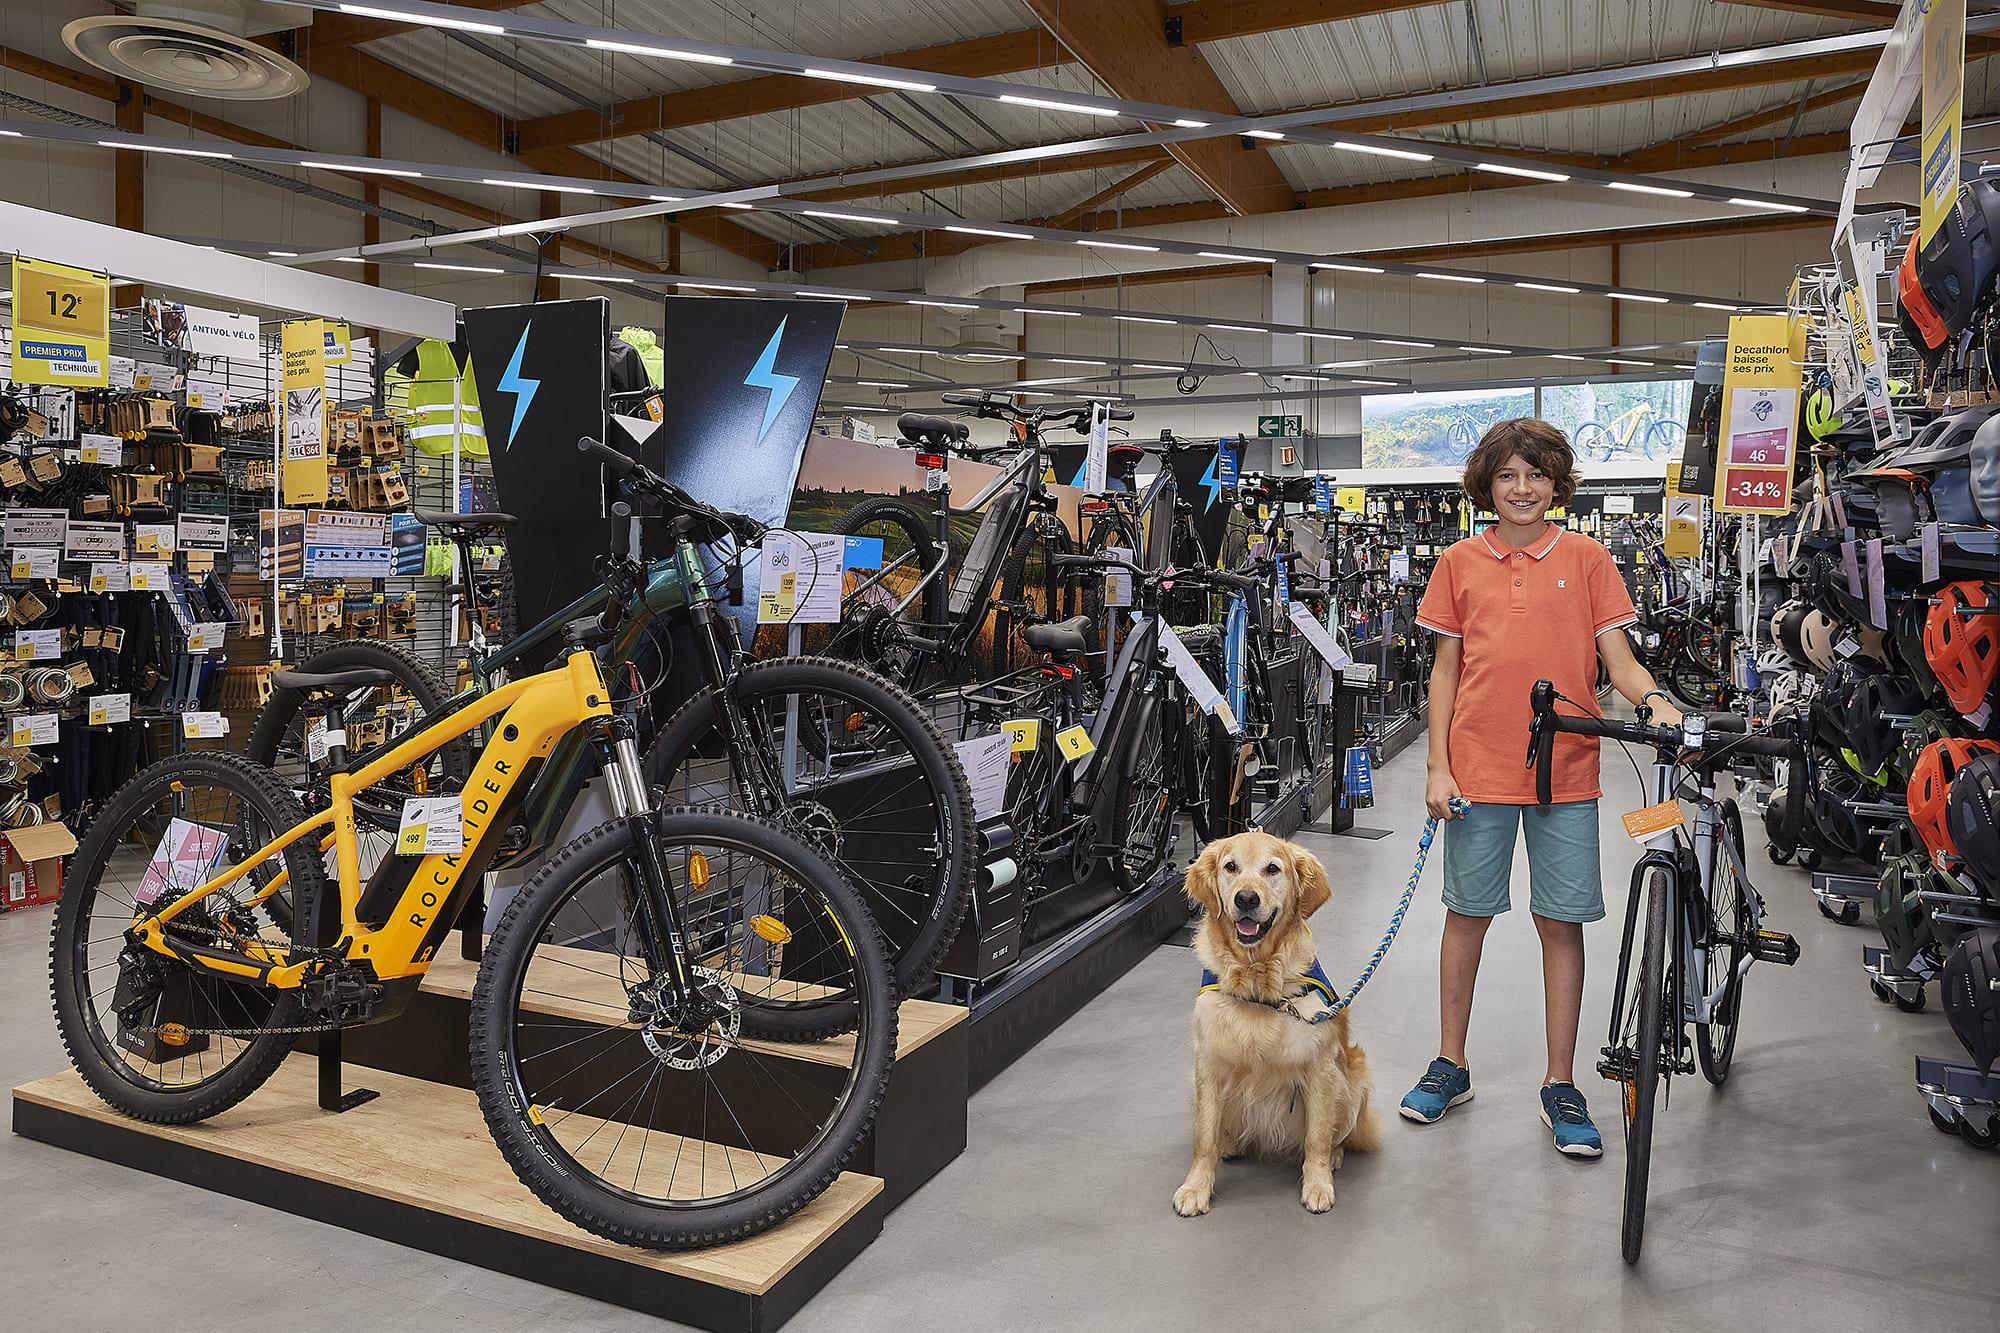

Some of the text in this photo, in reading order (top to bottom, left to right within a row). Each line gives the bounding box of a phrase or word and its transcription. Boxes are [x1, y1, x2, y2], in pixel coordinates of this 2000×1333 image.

[46, 291, 82, 319] 12€
[192, 326, 255, 341] ANTIVOL VÉLO
[25, 345, 83, 358] PREMIER PRIX
[286, 348, 317, 359] Decathlon
[1734, 345, 1789, 355] Decathlon
[286, 358, 306, 367] baisse
[1733, 355, 1768, 364] baisse
[53, 362, 98, 374] TECHNIQUE
[286, 366, 310, 376] ses prix
[1754, 364, 1775, 374] prix
[305, 445, 320, 455] 36€
[1731, 482, 1781, 498] -34%
[149, 771, 180, 788] GRIP
[505, 1082, 521, 1114] 100
[520, 1120, 557, 1167] GRIP
